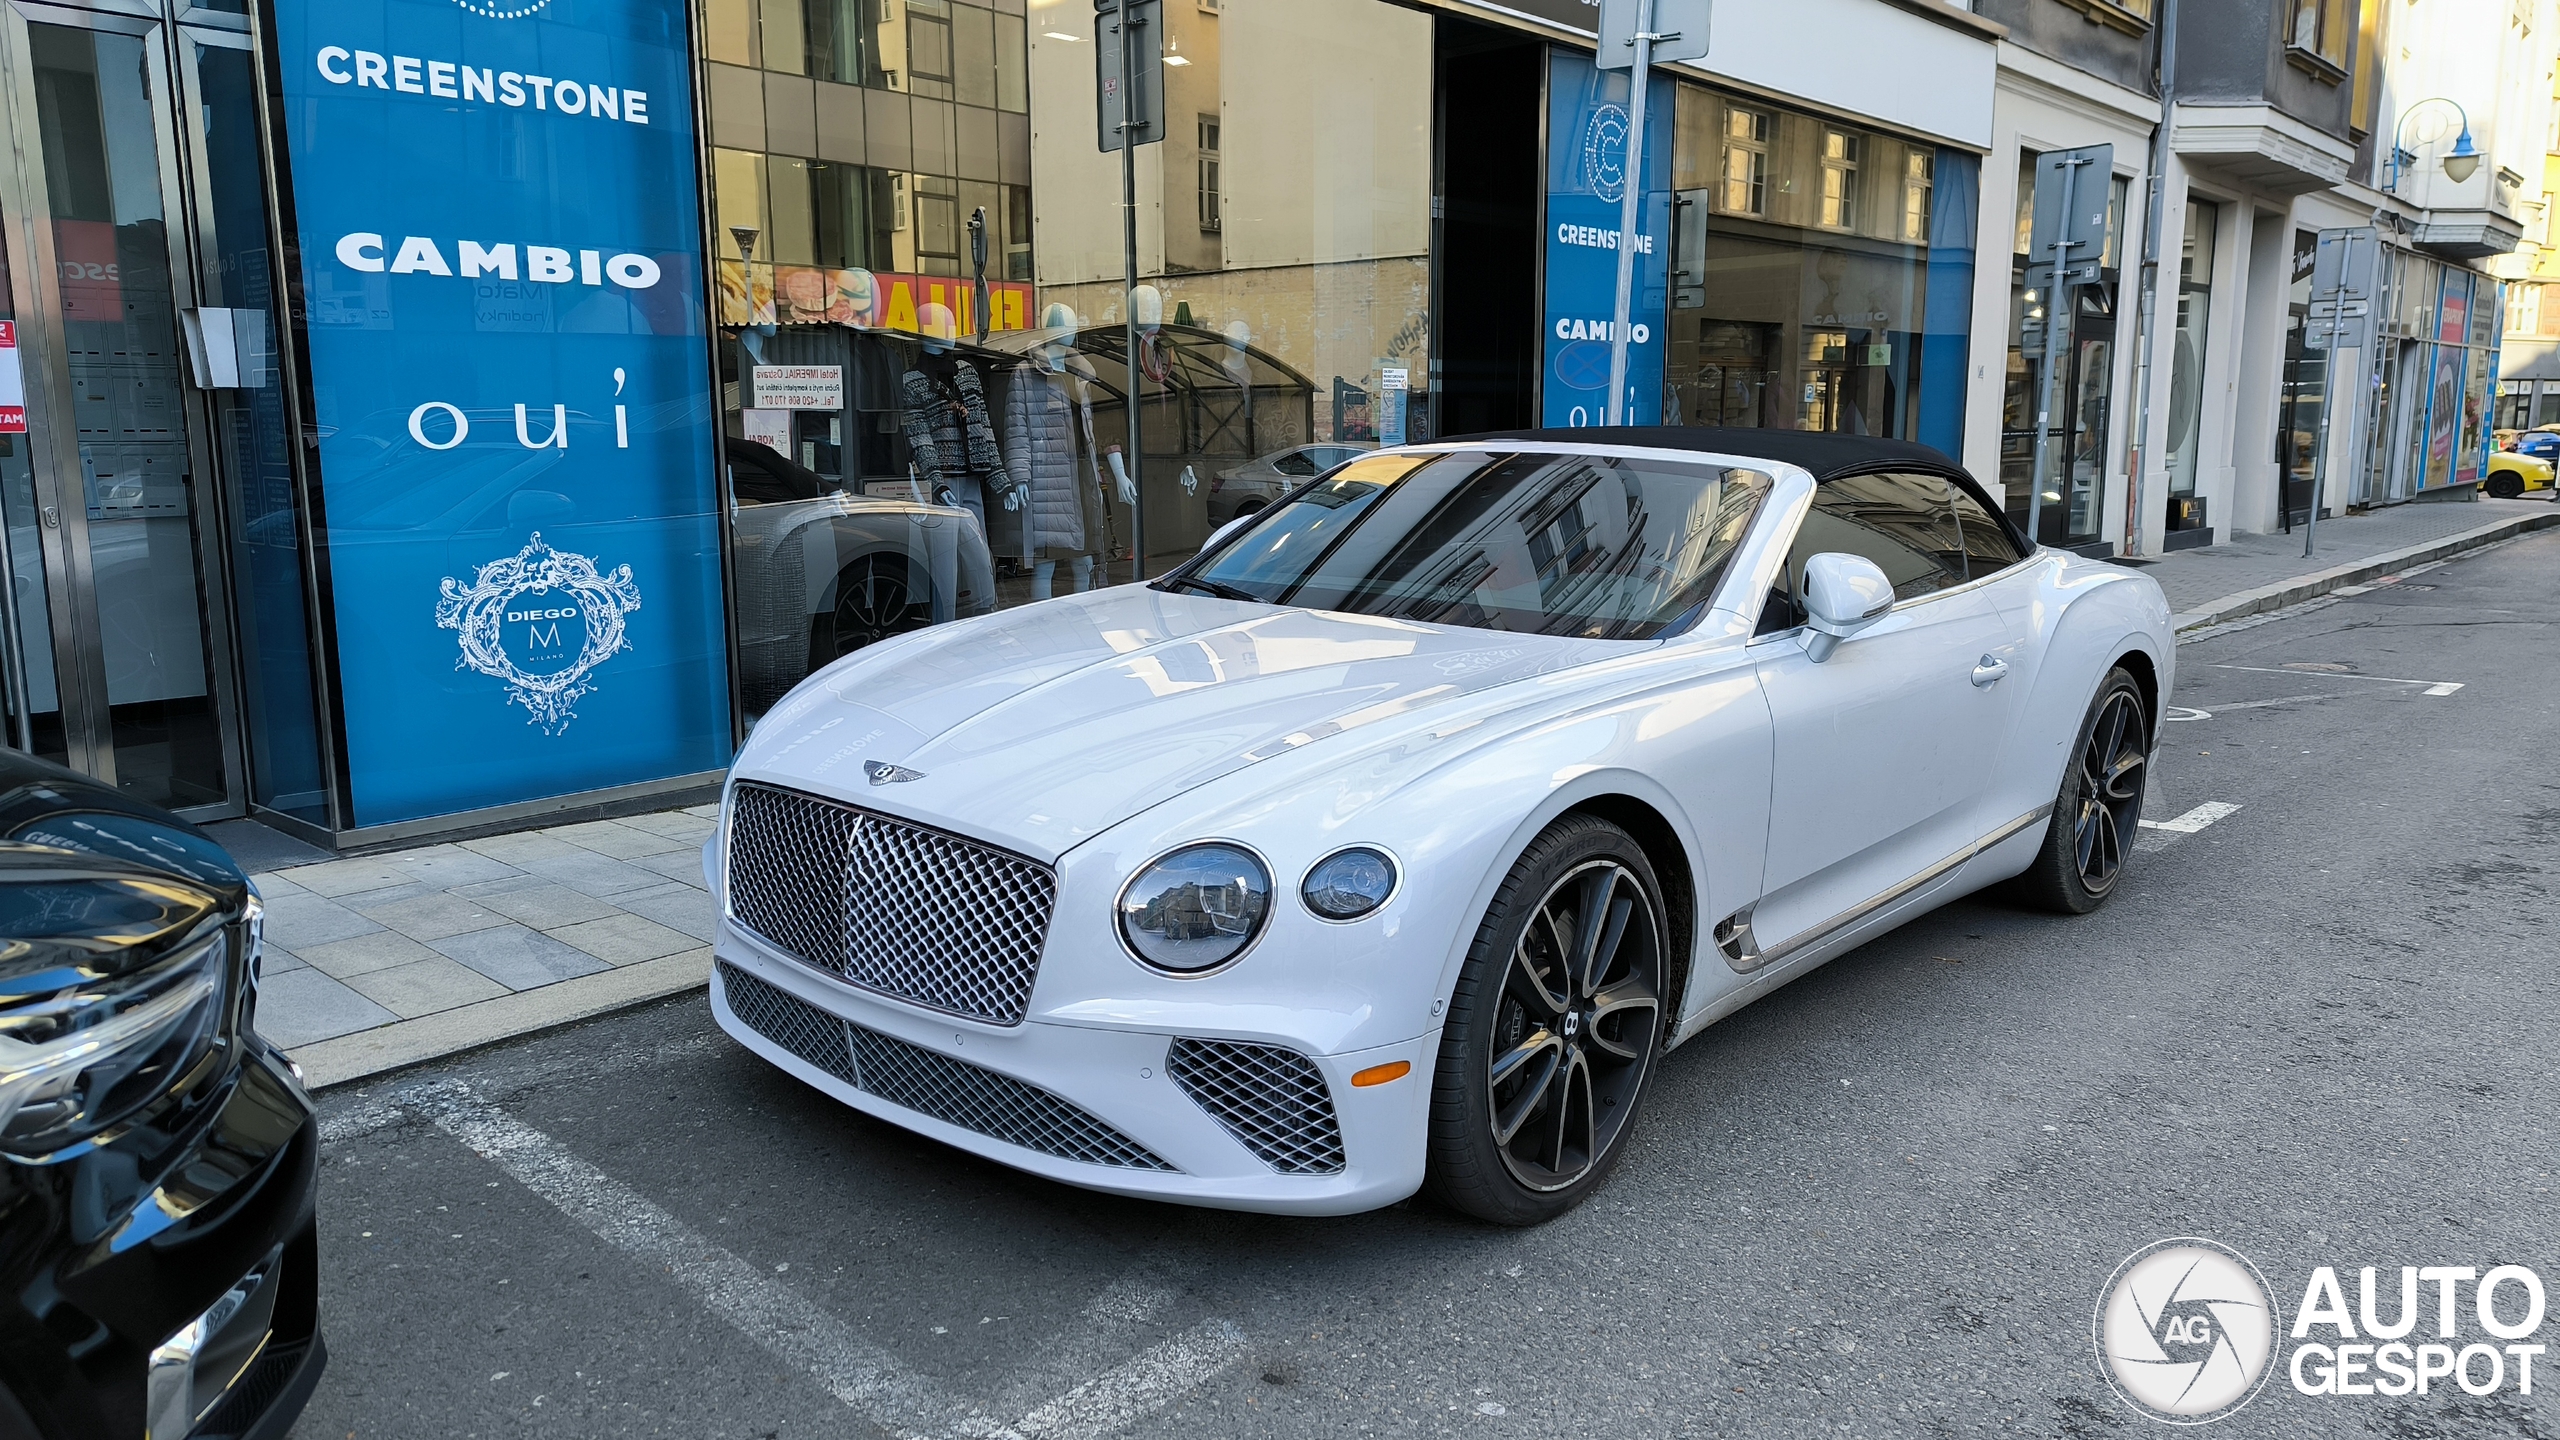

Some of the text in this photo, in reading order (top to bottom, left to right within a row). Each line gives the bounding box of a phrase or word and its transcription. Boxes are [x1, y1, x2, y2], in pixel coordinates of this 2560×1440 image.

[316, 45, 650, 125] CREENSTONE
[1557, 223, 1653, 254] CREENSTNE
[203, 253, 236, 276] Vstup B
[335, 232, 661, 289] CAMBIO
[507, 607, 577, 623] DIEGO
[529, 623, 561, 650] M
[529, 653, 564, 662] MILANO
